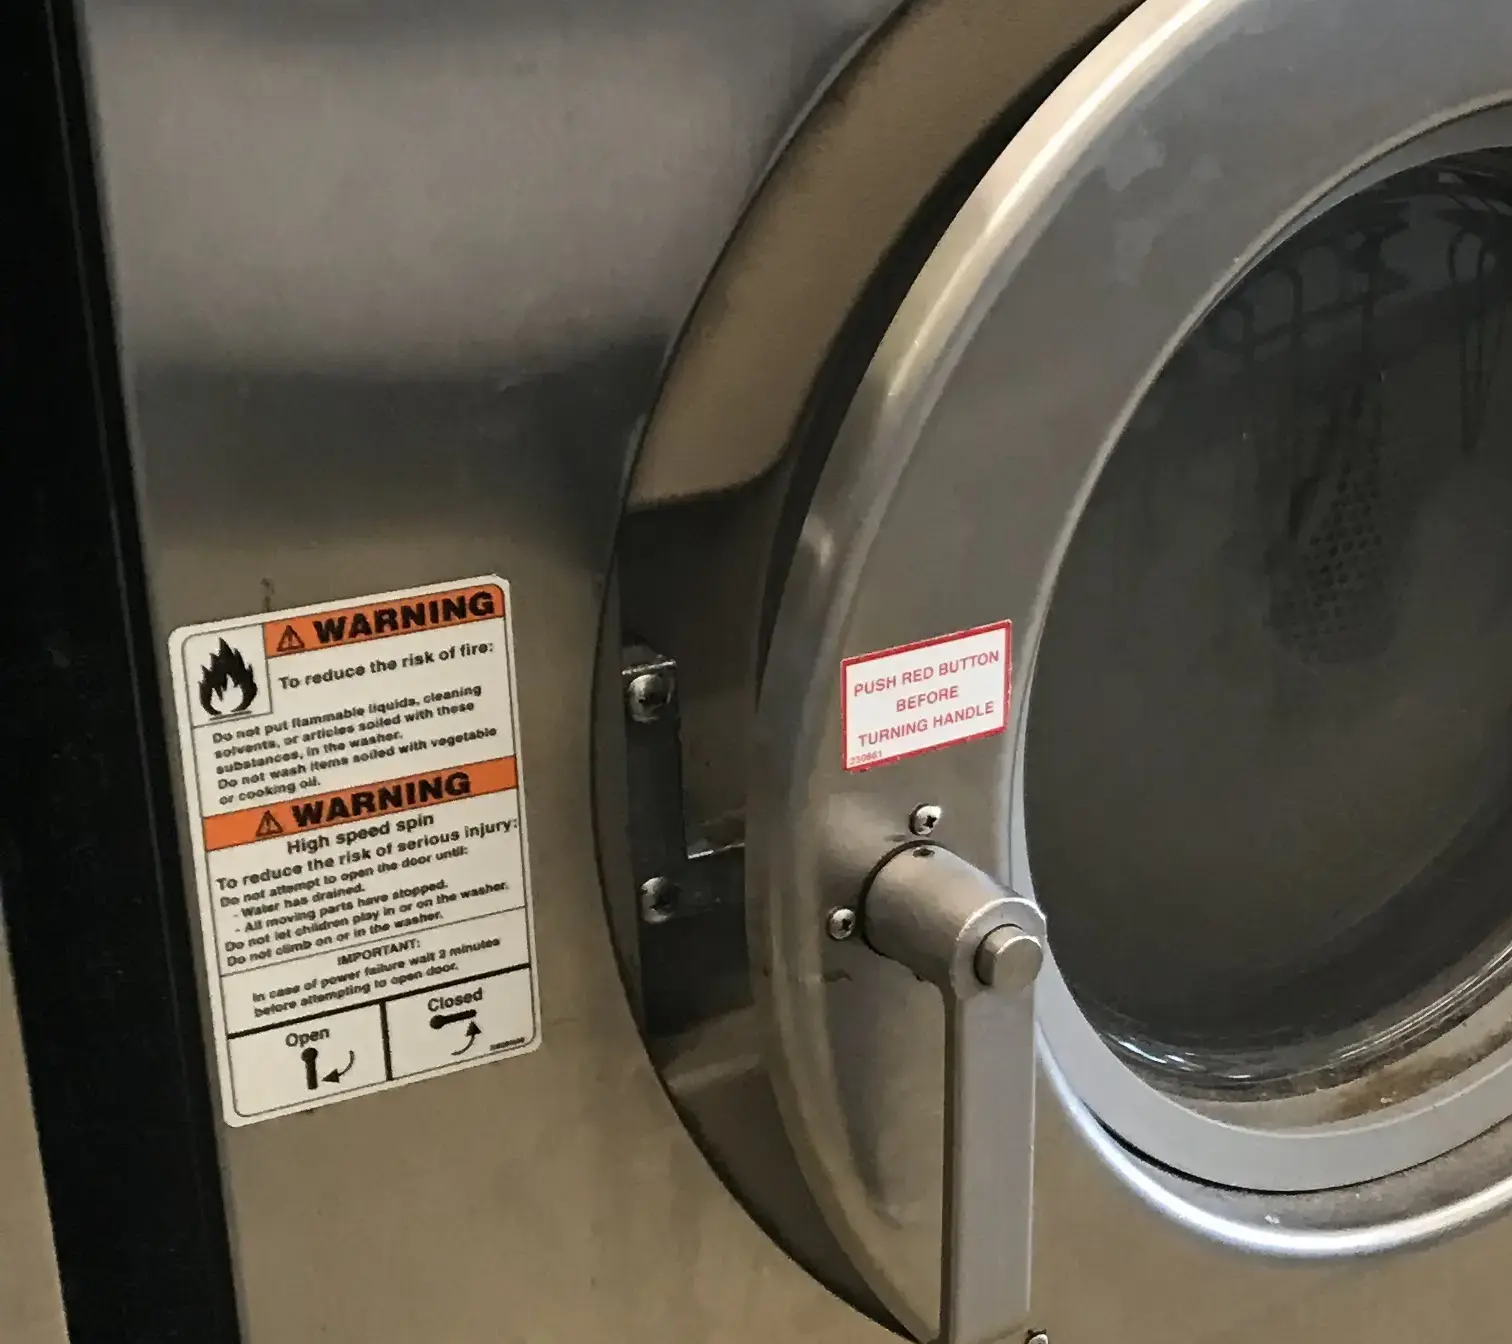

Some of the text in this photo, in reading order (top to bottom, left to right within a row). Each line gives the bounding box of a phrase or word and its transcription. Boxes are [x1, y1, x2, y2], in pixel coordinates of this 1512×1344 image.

[313, 590, 495, 644] WARNING
[278, 642, 493, 689] To reduce the risk of fire:
[854, 650, 999, 697] PUSH RED BUTTON
[212, 685, 482, 743] Do not put flammable liquids, cleaning
[858, 700, 994, 747] TURNING HANDLE
[896, 685, 959, 713] BEFORE
[214, 702, 474, 758] solvents, or articles soiled with these
[216, 730, 402, 774] substances, in the washer.
[217, 727, 497, 789] Do not wash items soiled with vegetable
[219, 775, 320, 805] or cooking oil.
[291, 771, 470, 827] WARNING
[215, 818, 517, 890] To reduce the risk of serious injury:
[286, 813, 434, 854] High speed spin
[219, 845, 468, 907] Do not attempt to open the door until:
[240, 882, 365, 917] Water has drained.
[224, 881, 508, 952] Do not let children play in or on the washer.
[244, 878, 448, 932] All moving parts have stopped.
[226, 910, 443, 966] Do not climb on or in the washer.
[337, 938, 420, 965] IMPORTANT:
[252, 993, 265, 1002] In
[269, 984, 300, 998] case
[303, 978, 317, 990] of
[320, 970, 360, 989] power
[363, 960, 405, 976] failure
[408, 951, 435, 965] wait
[448, 937, 500, 956] minutes
[254, 962, 458, 1017] before attempting to open door.
[427, 986, 483, 1012] Closed
[285, 1028, 330, 1047] Open
